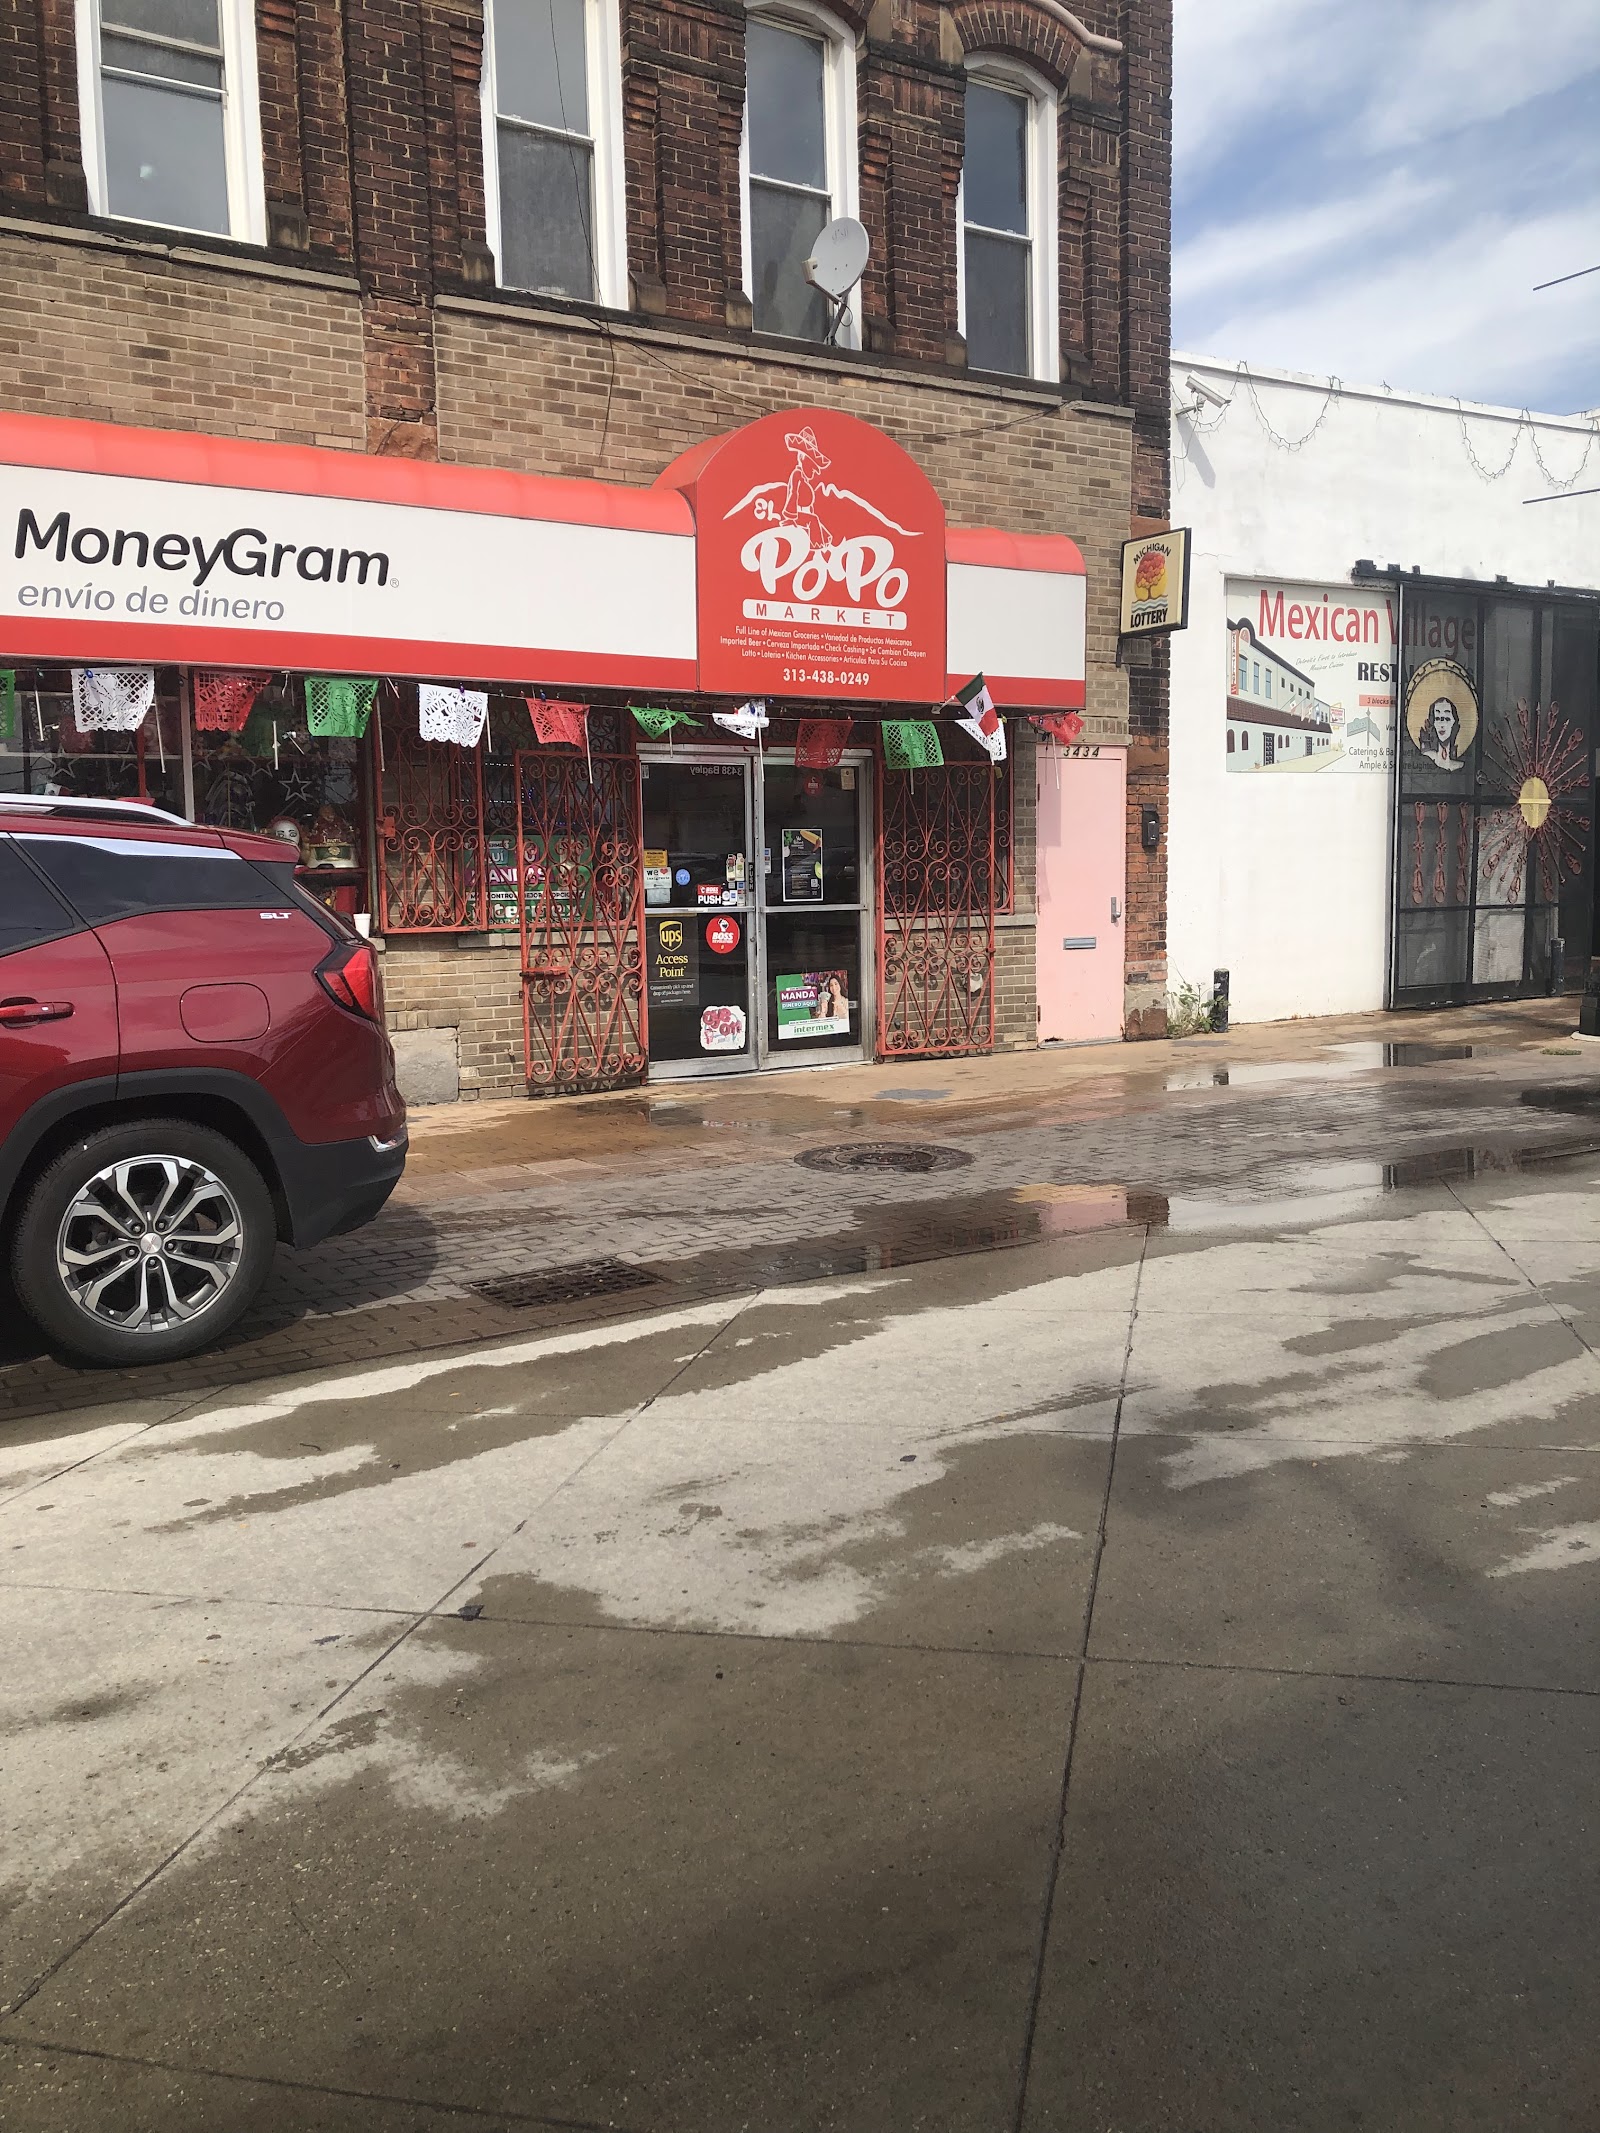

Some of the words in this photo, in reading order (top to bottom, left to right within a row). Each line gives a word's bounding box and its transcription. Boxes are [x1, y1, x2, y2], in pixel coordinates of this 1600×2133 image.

[15, 508, 390, 587] MoneyGram
[1133, 542, 1171, 564] MICHIGAN
[18, 582, 115, 611] envío
[125, 585, 169, 614] de
[179, 589, 285, 621] dinero
[756, 603, 895, 626] MARKET
[1130, 608, 1169, 628] LOTTERY
[1258, 589, 1380, 644] Mexican
[1386, 598, 1476, 660] Village
[735, 625, 747, 634] Full
[747, 626, 760, 636] Line
[761, 627, 768, 636] of
[768, 628, 792, 638] Mexican
[793, 630, 820, 640] Groceries
[824, 632, 849, 642] Variedad
[850, 634, 857, 643] de
[858, 634, 884, 644] Productos
[720, 636, 747, 646] Imported
[748, 637, 762, 647] Beer
[766, 638, 790, 649] Cerveza
[791, 640, 820, 651] Importada
[824, 643, 842, 652] Check
[843, 644, 865, 655] Cashing
[869, 646, 877, 655] Se
[741, 648, 757, 657] Lotto
[785, 651, 807, 660] Kitchen
[807, 653, 839, 662] Accessories
[868, 656, 880, 665] Para
[881, 657, 888, 666] Su
[889, 658, 908, 667] Cocina
[783, 667, 870, 686] 313-438-0249
[1063, 746, 1100, 757] 3434
[1348, 747, 1378, 758] Catering
[1359, 760, 1382, 771] Ample
[697, 895, 722, 905] PUSH
[260, 912, 292, 920] SLT
[661, 930, 681, 947] ups
[712, 931, 734, 940] BOSS
[655, 953, 689, 965] Access
[659, 966, 685, 977] Point
[781, 990, 815, 1001] MANDA
[782, 1001, 801, 1009] DINERO
[793, 1023, 835, 1034] intermex
